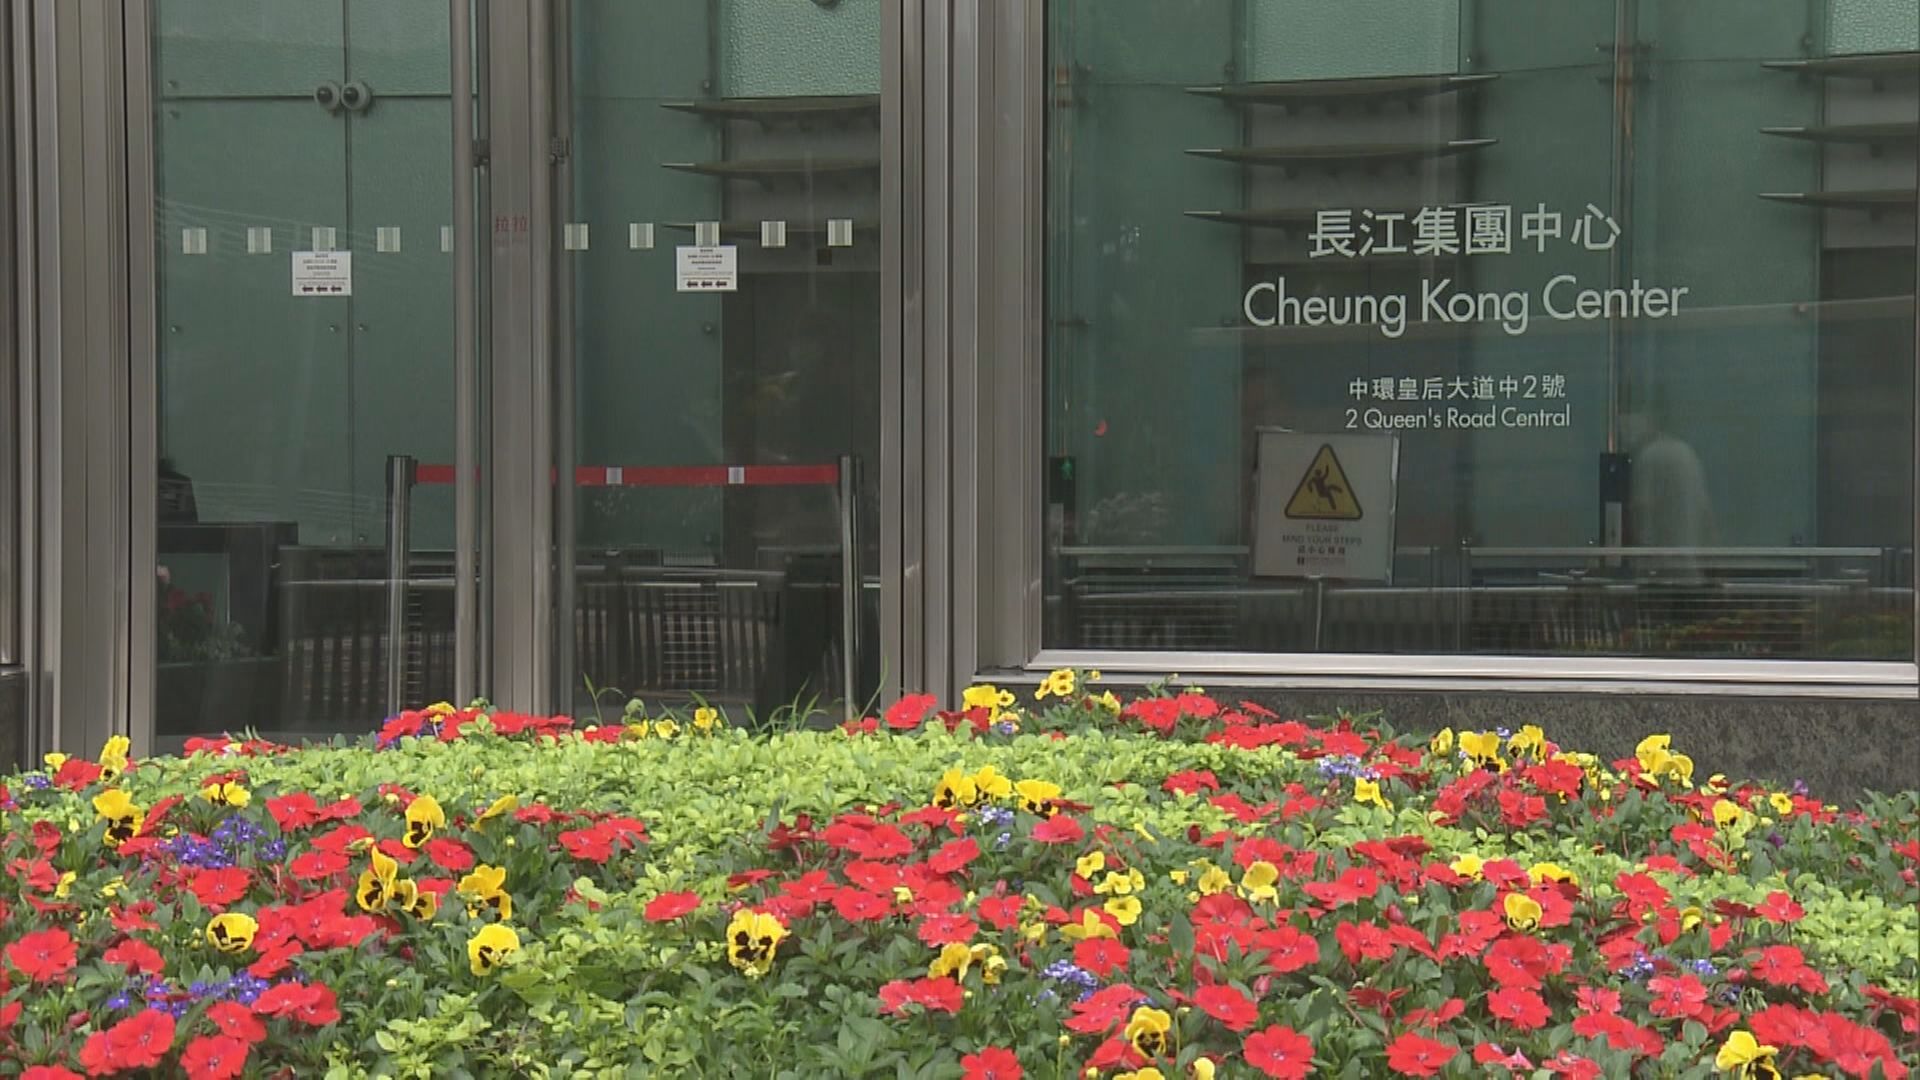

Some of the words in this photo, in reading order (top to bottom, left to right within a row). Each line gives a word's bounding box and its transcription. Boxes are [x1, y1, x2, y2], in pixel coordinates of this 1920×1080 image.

[1308, 202, 1621, 258] 長江集團中心
[1243, 277, 1406, 338] Cheung
[1421, 278, 1529, 335] Kong
[1543, 274, 1689, 320] Center
[1348, 374, 1567, 402] 中環皇后大道中2號
[1345, 408, 1358, 429] 2
[1363, 406, 1442, 430] Queen's
[1447, 405, 1496, 428] Road
[1501, 403, 1570, 427] Central
[1282, 534, 1305, 544] MIND
[1307, 535, 1332, 544] YOUR
[1305, 523, 1339, 533] PLEASE
